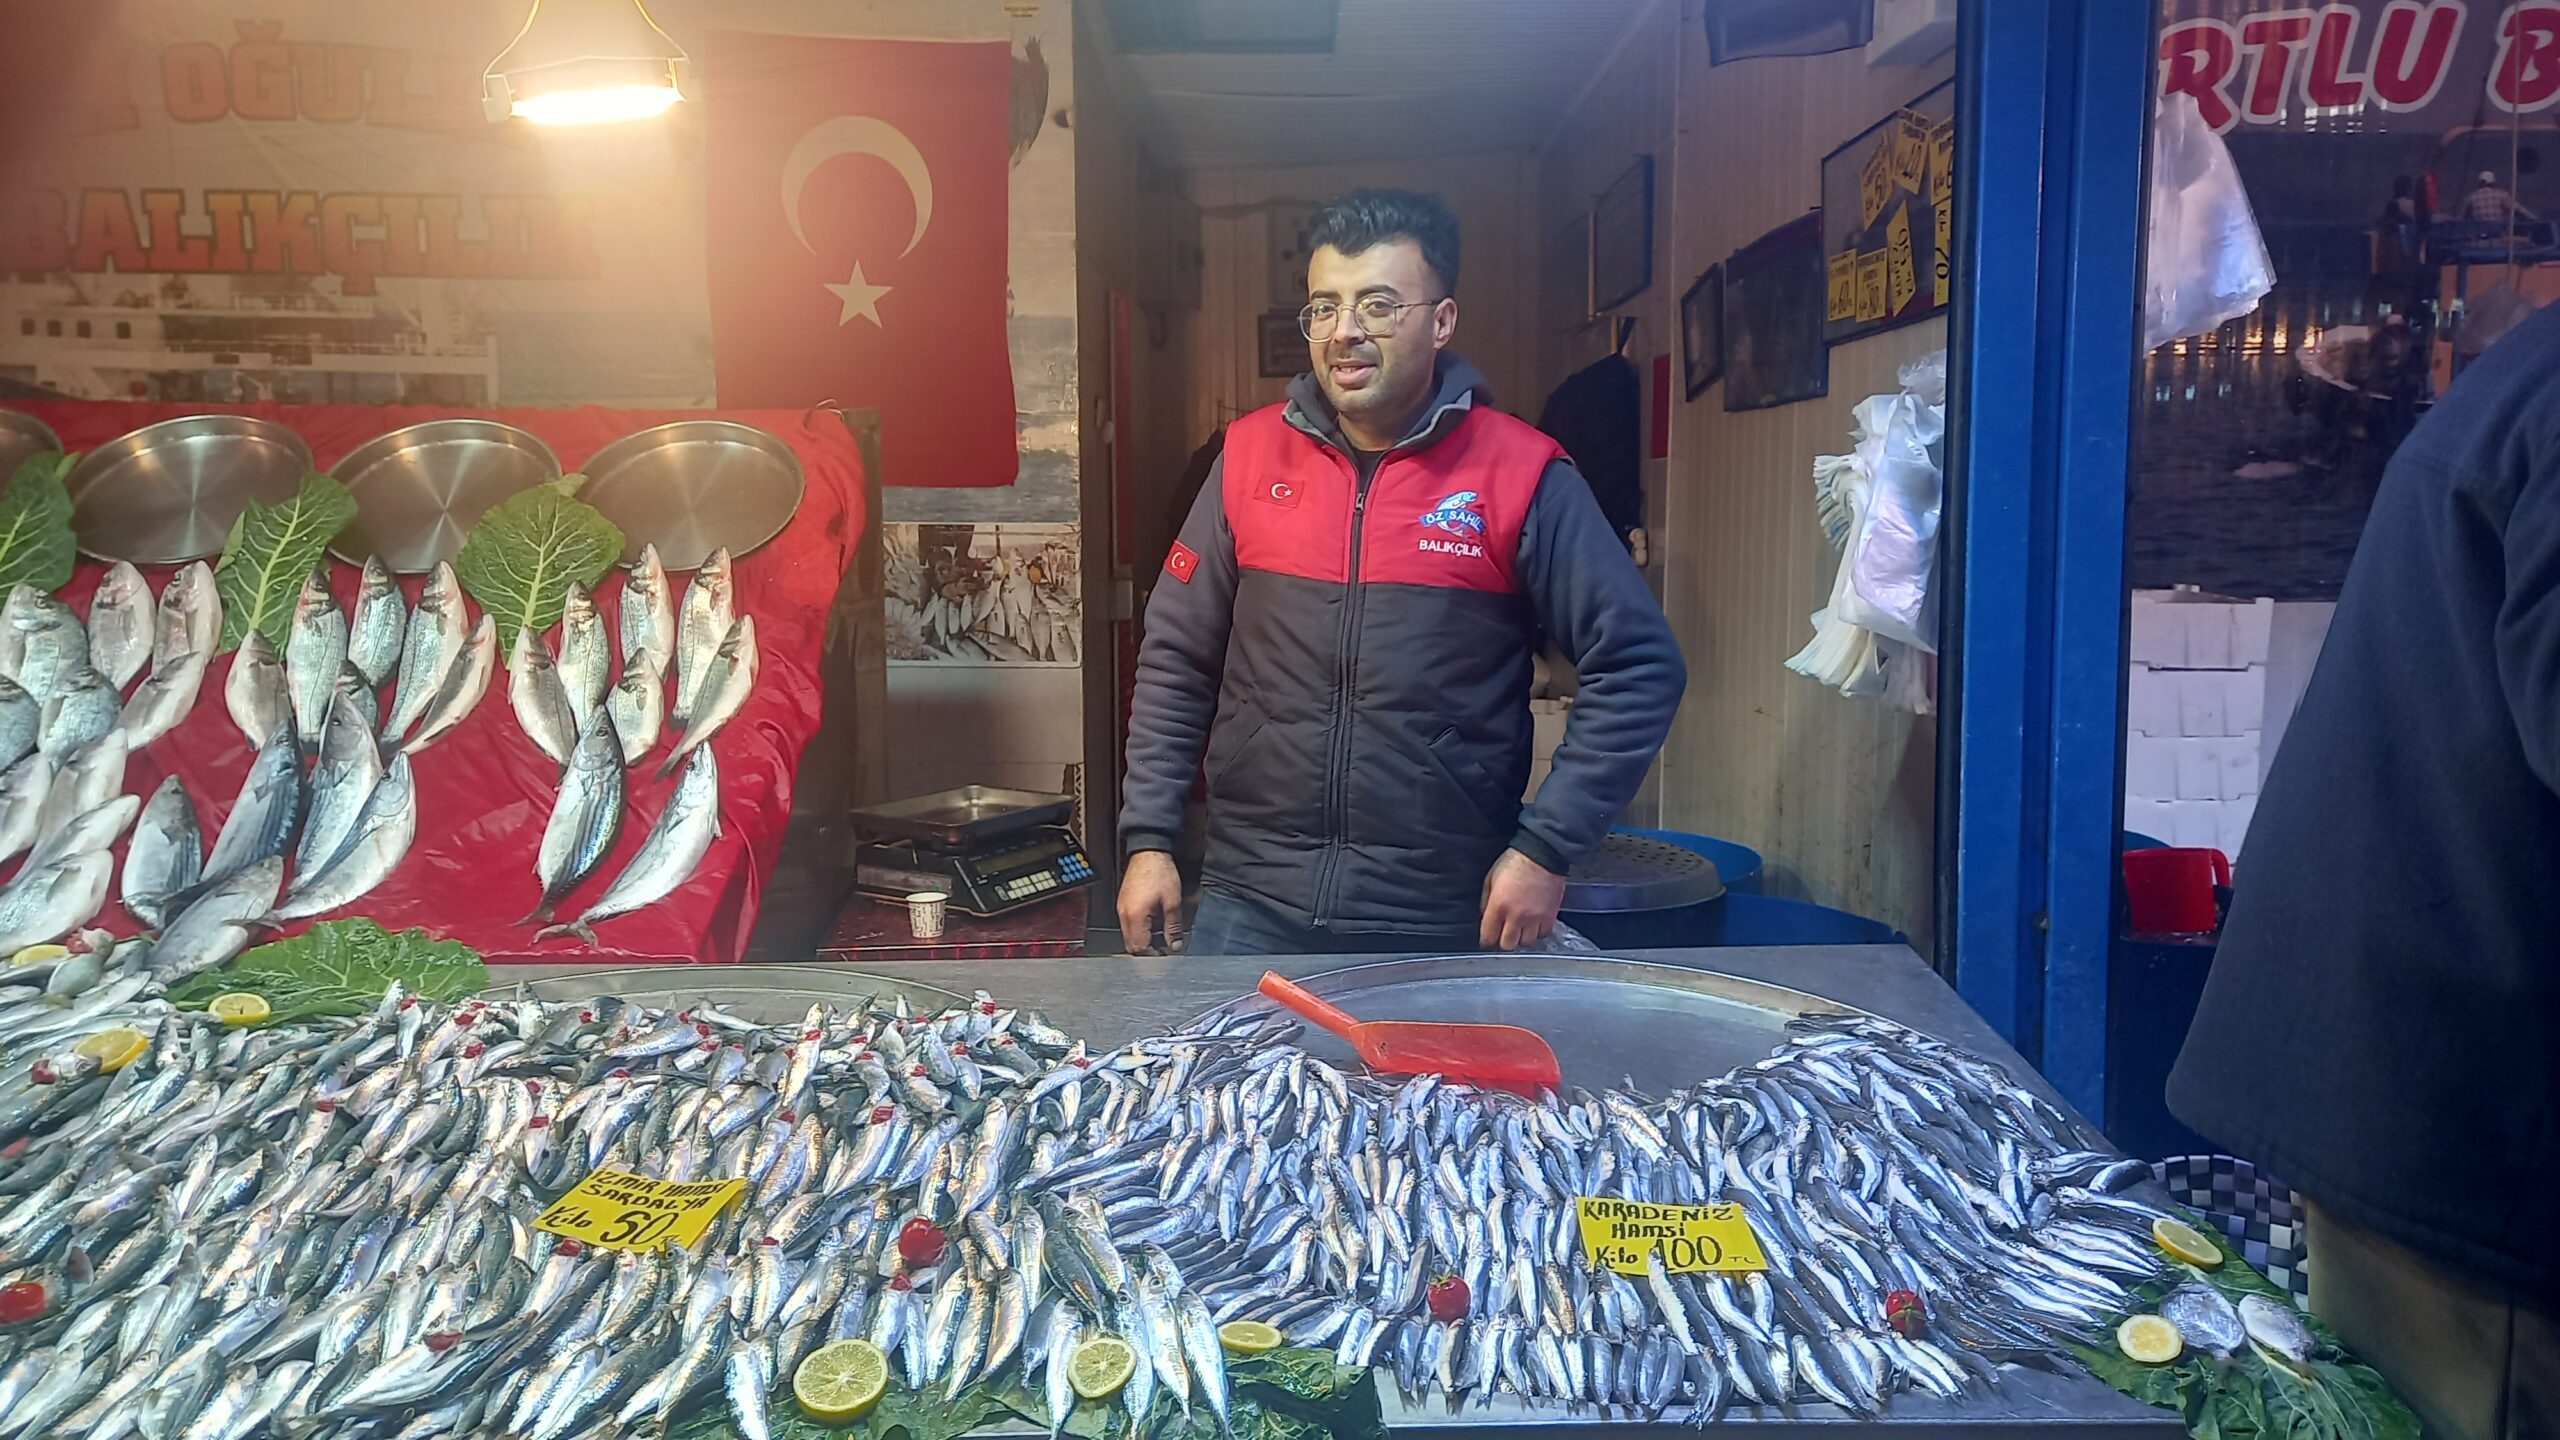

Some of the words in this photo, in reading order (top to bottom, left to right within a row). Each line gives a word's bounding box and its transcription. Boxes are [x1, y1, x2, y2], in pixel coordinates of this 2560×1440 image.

[1426, 511, 1444, 523] ÖZ
[1420, 539, 1482, 557] BALIKÇILIK
[581, 1184, 713, 1212] SARDALYA
[541, 1206, 592, 1229] Kilo
[1653, 1235, 1722, 1272] 100
